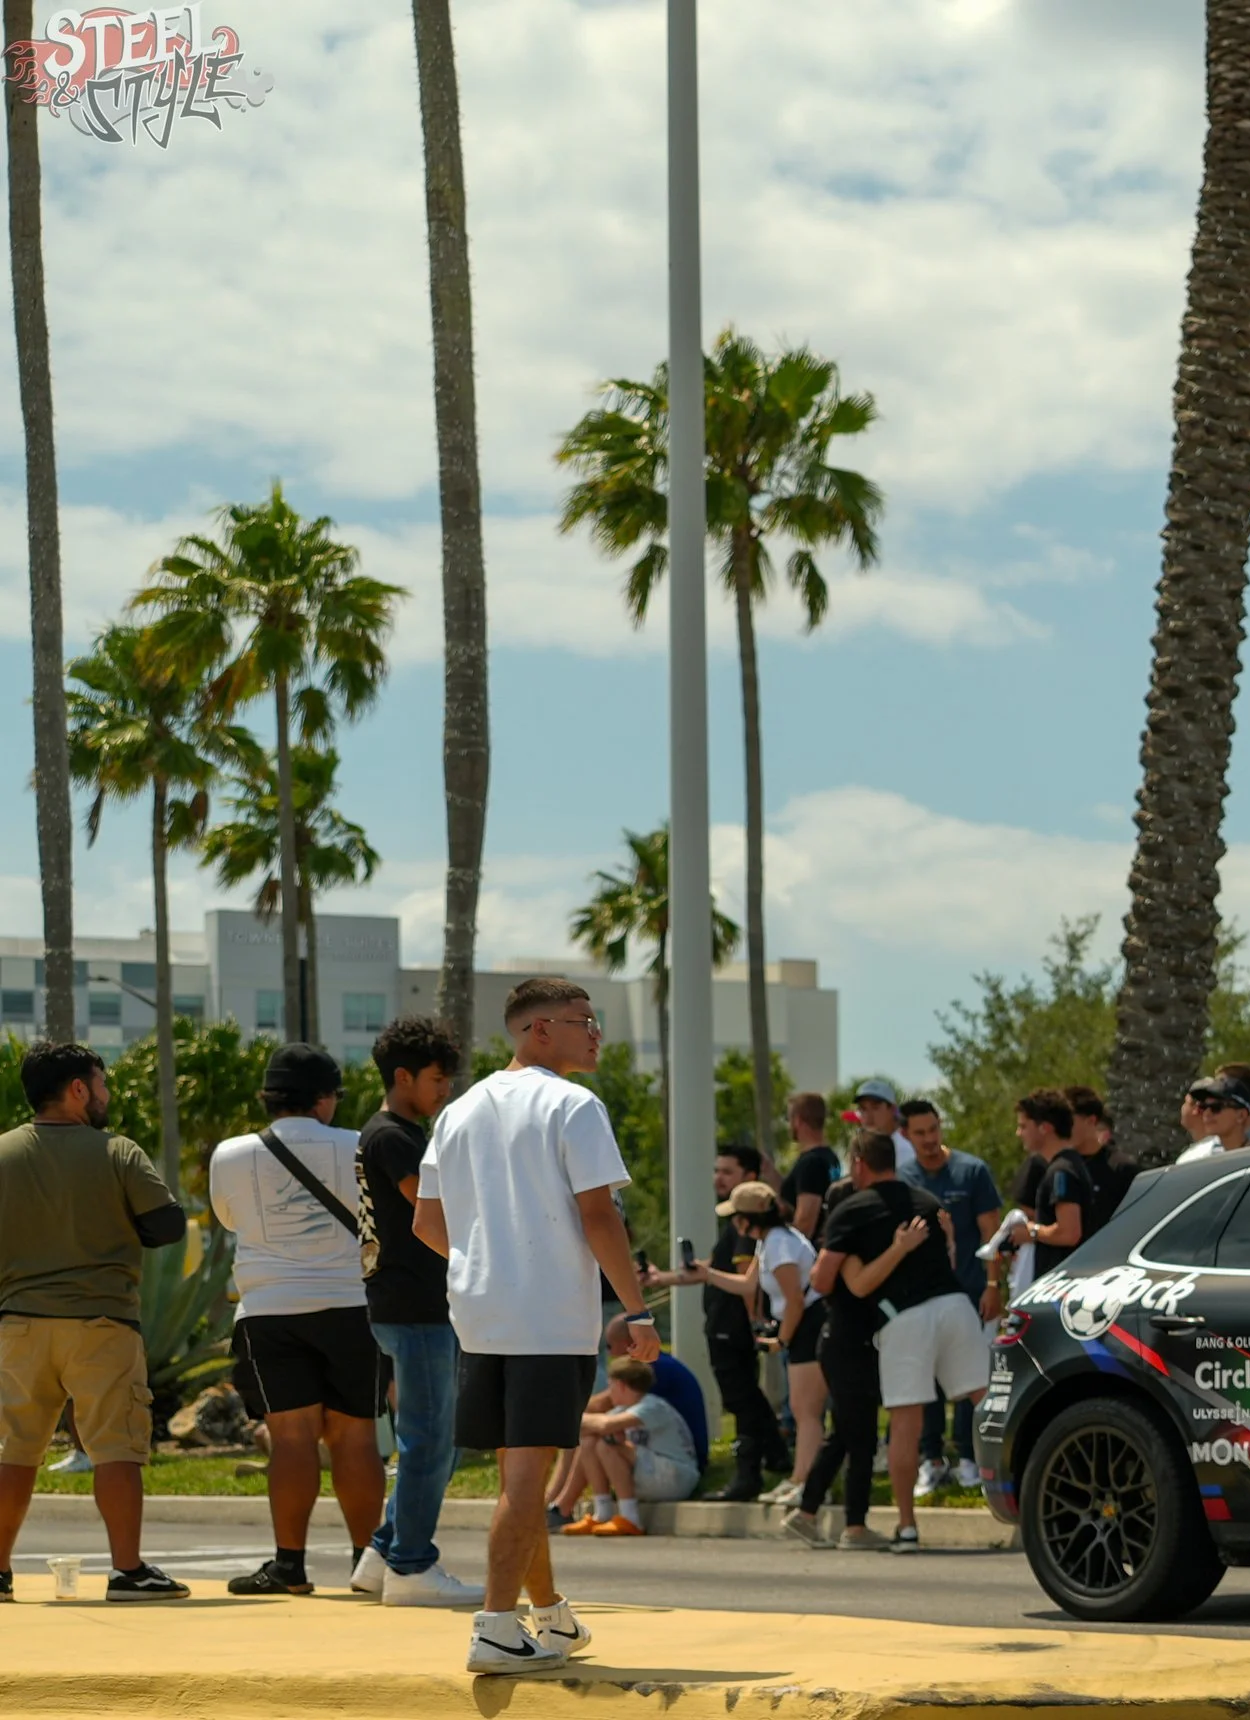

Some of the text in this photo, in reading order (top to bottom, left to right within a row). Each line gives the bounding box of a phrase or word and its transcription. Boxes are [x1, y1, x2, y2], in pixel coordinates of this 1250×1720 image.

[1195, 1337, 1225, 1349] BANG
[1226, 1336, 1235, 1348] &
[1193, 1408, 1235, 1419] ULYSSE
